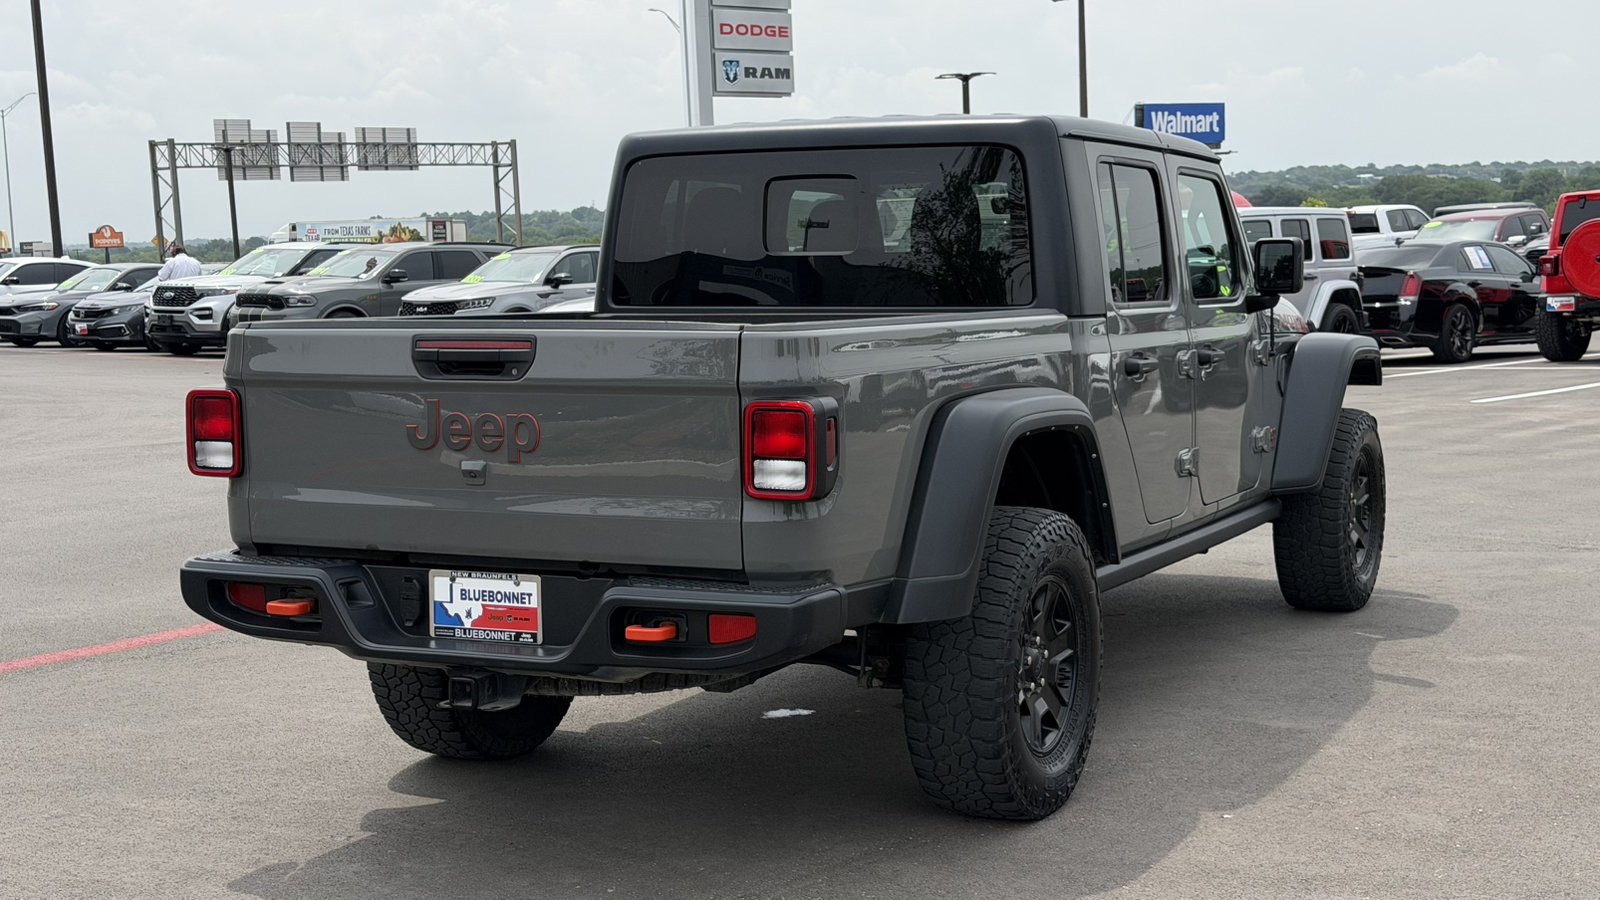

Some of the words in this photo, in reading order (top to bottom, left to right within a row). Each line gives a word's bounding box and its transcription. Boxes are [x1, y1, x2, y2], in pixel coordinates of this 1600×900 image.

[719, 23, 789, 38] DODGE
[743, 66, 791, 80] RAM
[1150, 111, 1220, 133] Walmart
[323, 228, 340, 236] FROM
[340, 226, 354, 237] TEXAS
[354, 225, 371, 236] FARMS
[405, 398, 541, 465] Jeep
[470, 572, 517, 580] BRAUNFELS
[460, 588, 533, 604] BLUEBONNET
[454, 628, 516, 641] BLUEBONNET
